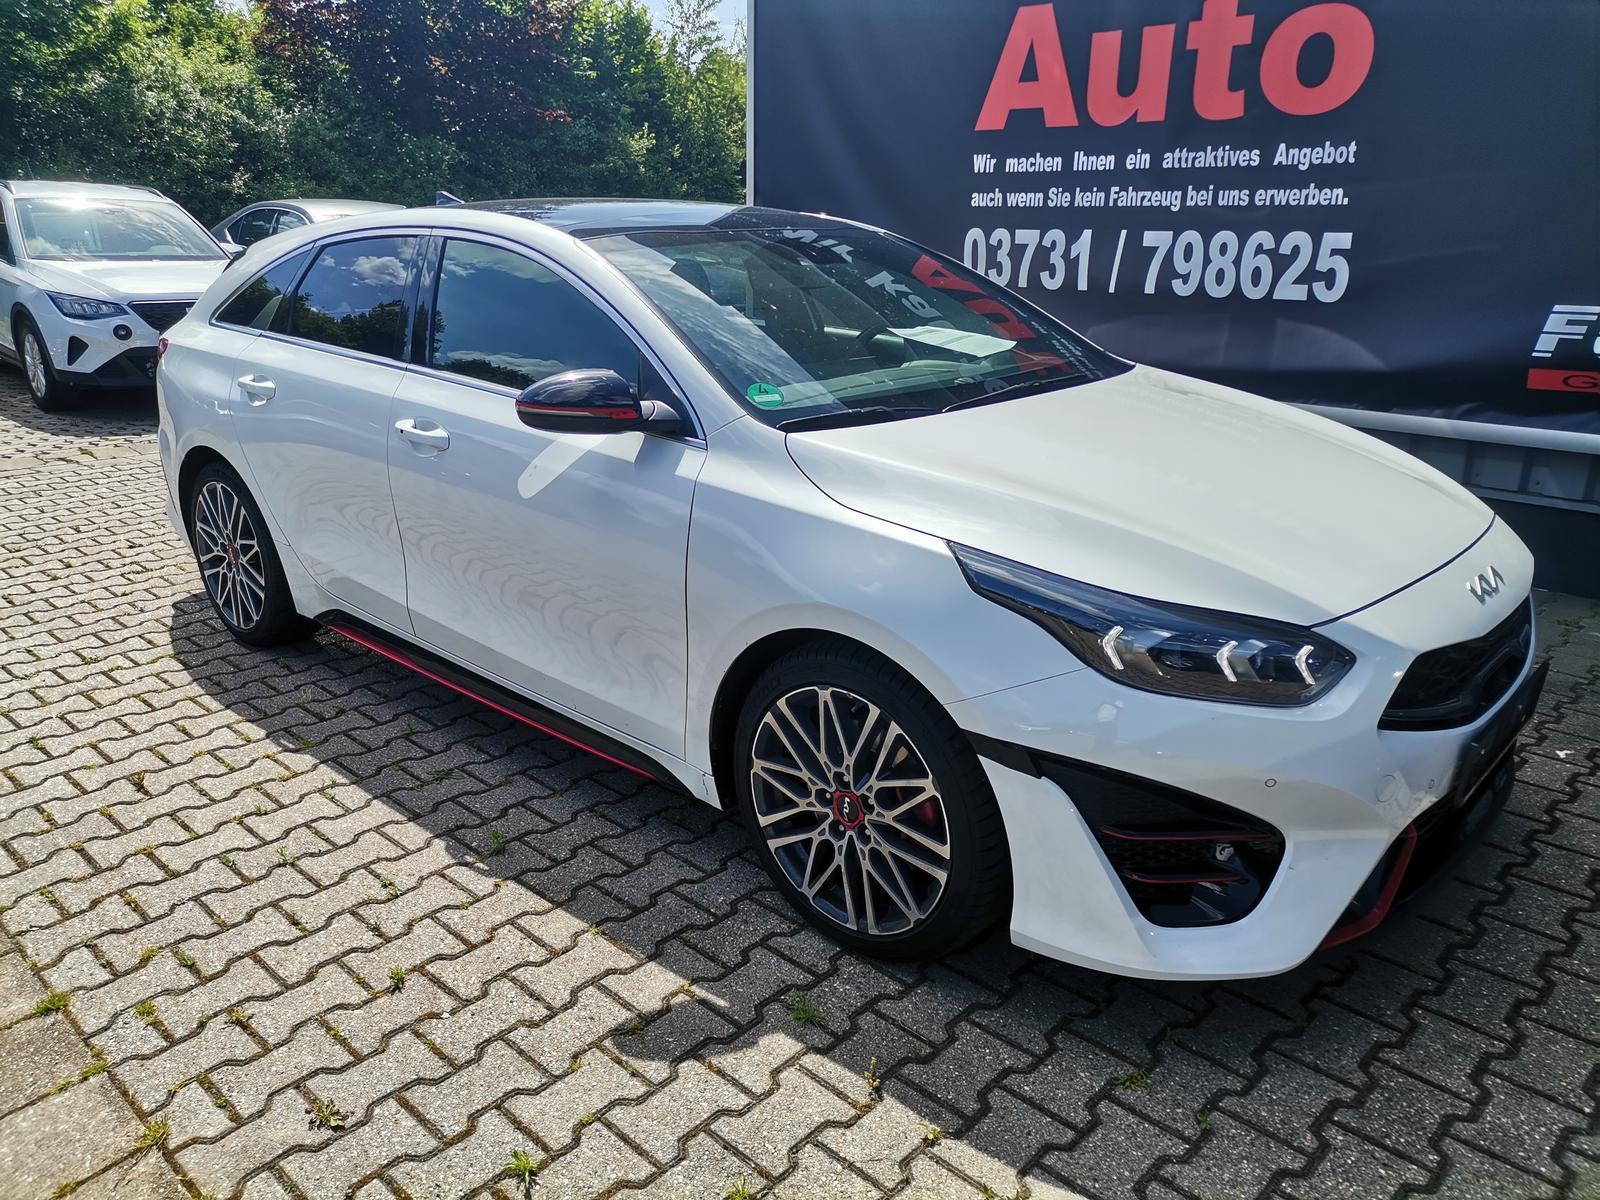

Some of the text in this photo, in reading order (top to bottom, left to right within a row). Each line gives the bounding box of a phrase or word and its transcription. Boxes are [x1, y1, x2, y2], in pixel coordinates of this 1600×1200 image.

[974, 0, 1376, 132] Auto
[973, 141, 1357, 173] Wir machen Ihnen ein attraktives Angebot
[971, 184, 1349, 211] auch wenn Sie kein Fahrzeug bei uns erwerben.
[964, 227, 1353, 303] 03731 / 798625
[1531, 304, 1600, 358] F
